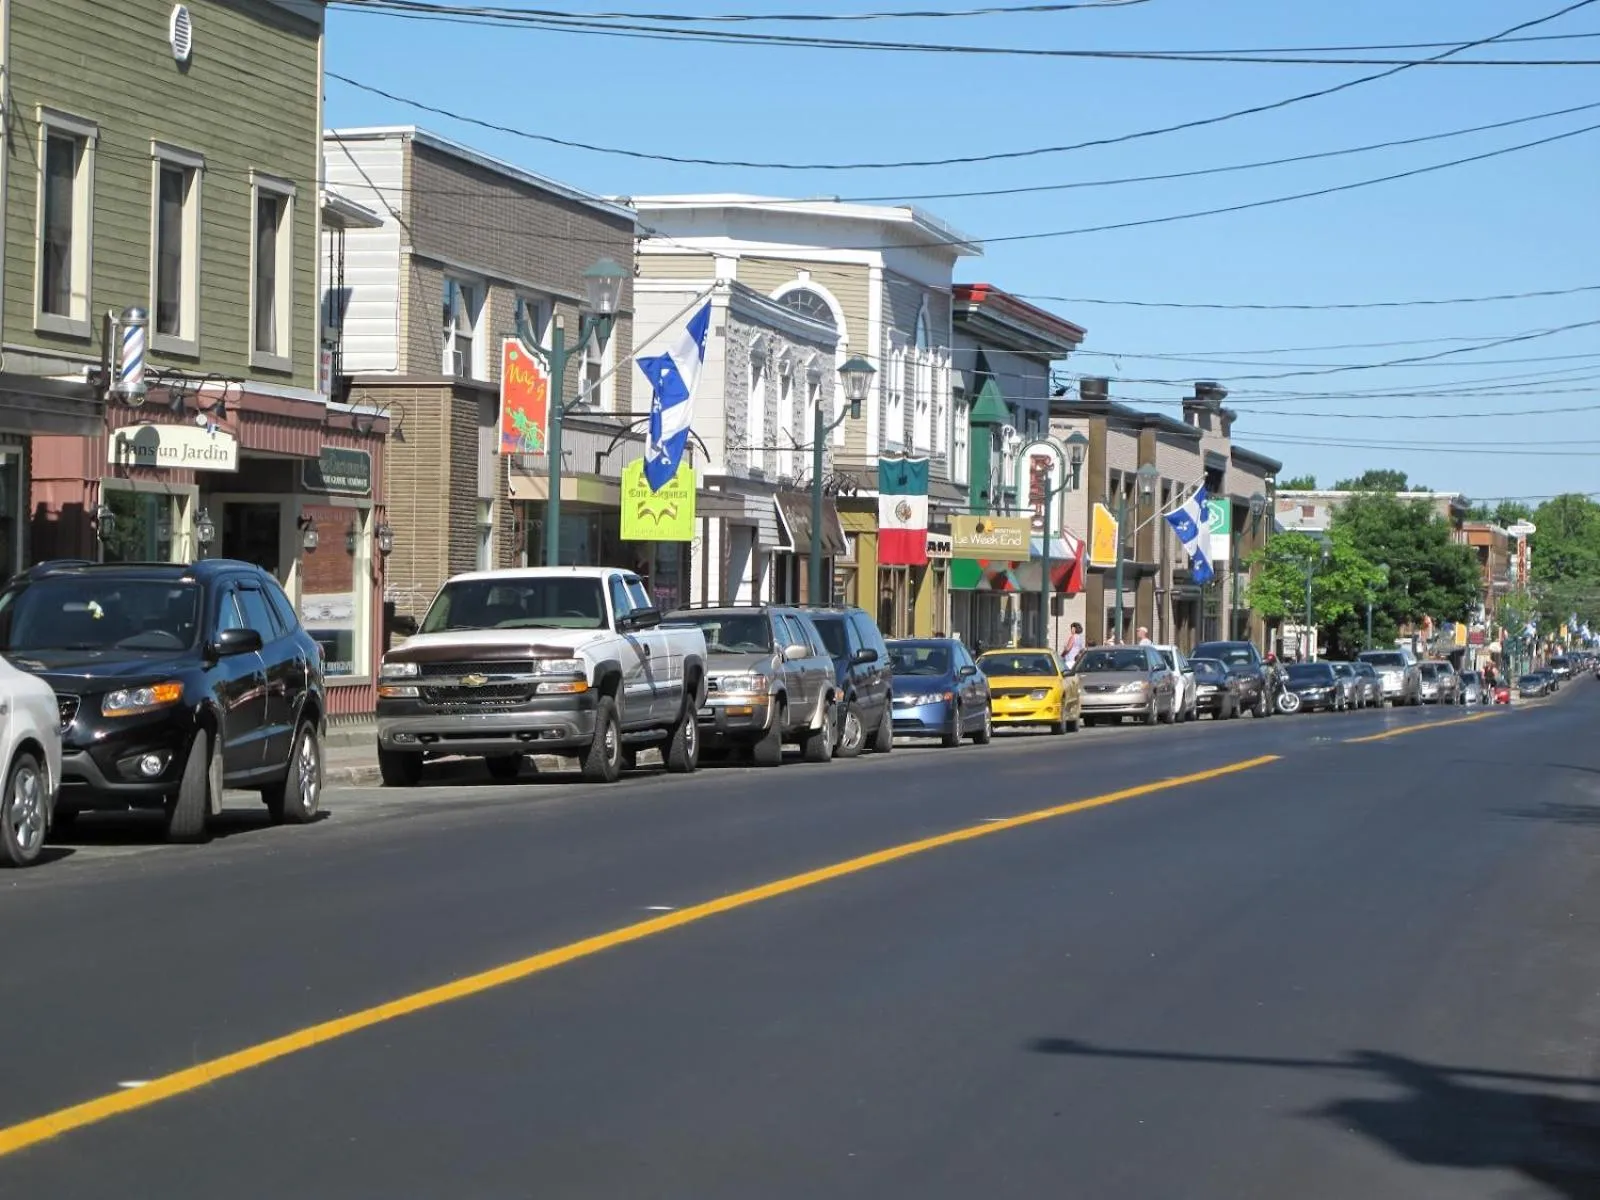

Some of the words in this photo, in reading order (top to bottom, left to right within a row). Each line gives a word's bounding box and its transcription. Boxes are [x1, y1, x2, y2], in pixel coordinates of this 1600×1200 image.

[117, 440, 155, 457] Dans
[159, 446, 178, 458] un
[181, 443, 228, 462] Jardin
[954, 533, 968, 544] Le
[970, 533, 998, 545] Week
[1000, 533, 1022, 546] End
